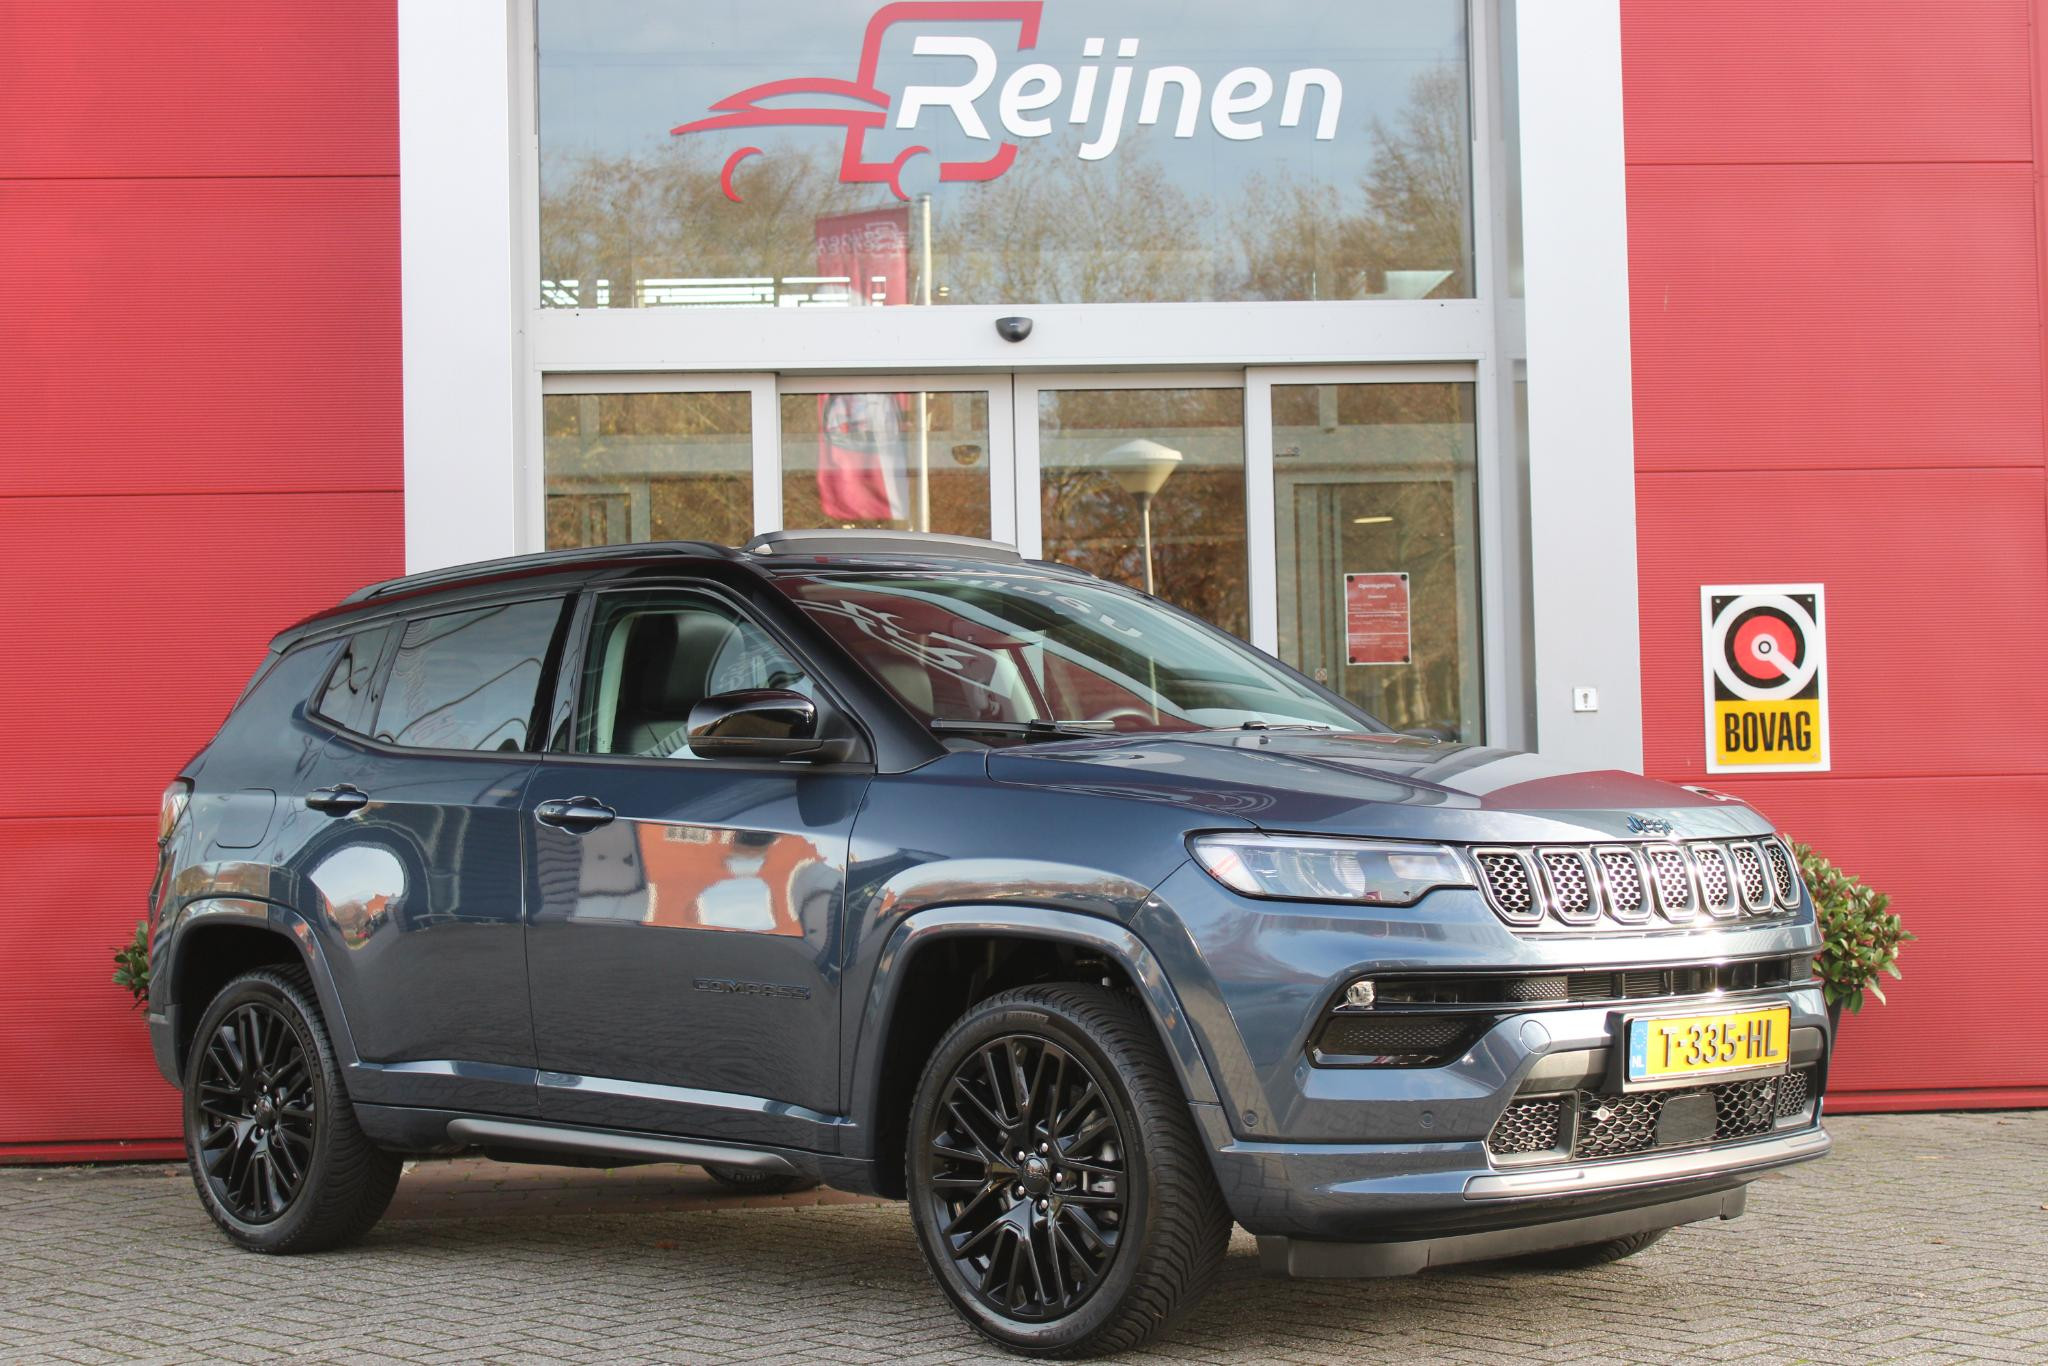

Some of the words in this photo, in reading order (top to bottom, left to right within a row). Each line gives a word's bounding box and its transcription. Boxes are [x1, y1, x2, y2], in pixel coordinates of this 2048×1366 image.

[896, 36, 1343, 160] Reijnen
[1724, 711, 1811, 752] BOVAG
[1627, 815, 1673, 836] Jeep
[693, 978, 811, 1000] COMPASS
[1660, 1019, 1778, 1067] T-335-HL
[1631, 1056, 1645, 1068] NL
